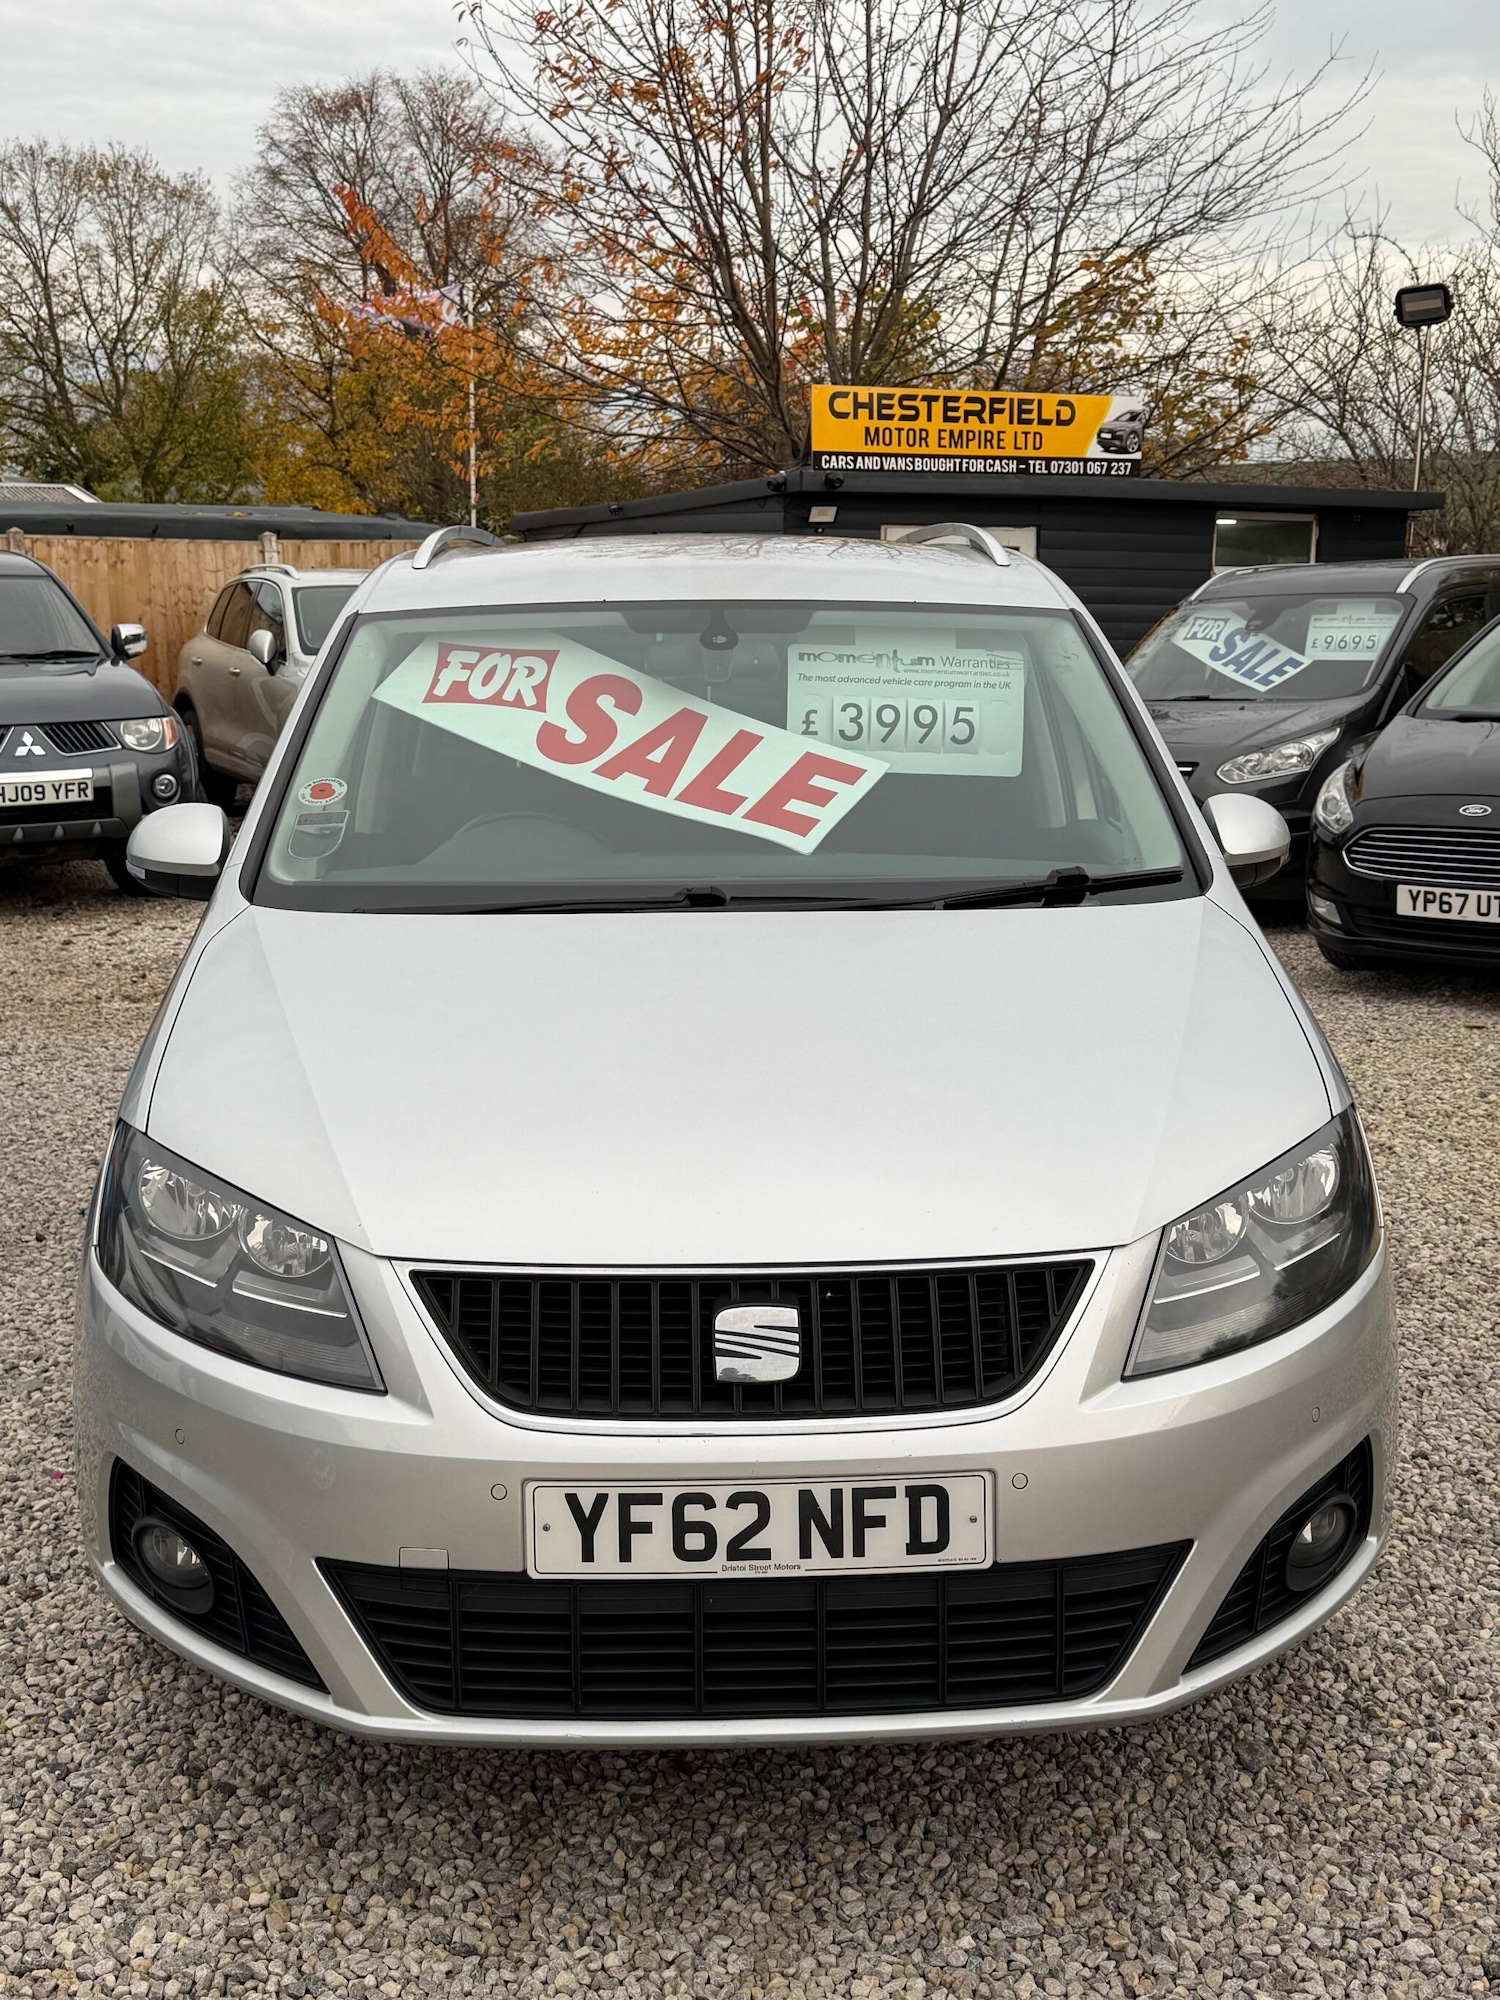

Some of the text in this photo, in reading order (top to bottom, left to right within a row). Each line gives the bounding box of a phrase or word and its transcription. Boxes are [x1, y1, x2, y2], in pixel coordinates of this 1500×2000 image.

[828, 391, 1076, 426] CHESTERFIELD
[864, 426, 1043, 451] MOTOR EMPIRE LTD
[821, 455, 854, 469] CARS
[856, 456, 881, 469] AND
[881, 457, 914, 471] VANS
[914, 458, 962, 472] BOUGHT
[963, 458, 985, 472] FOR
[986, 459, 1017, 473] CASH
[1028, 460, 1048, 474] TEL
[1050, 460, 1086, 475] 07301
[1087, 461, 1109, 475] 067
[1111, 461, 1132, 476] 237
[1186, 618, 1225, 641] FOR
[798, 649, 1011, 673] momentum Warranties
[1209, 627, 1304, 687] SALE
[432, 648, 549, 708] FOR
[798, 673, 813, 682] The
[815, 674, 836, 683] most
[837, 675, 880, 684] advanced
[882, 677, 912, 686] vehicle
[934, 680, 972, 690] program
[973, 681, 981, 689] in
[983, 681, 997, 689] the
[999, 681, 1012, 690] UK
[902, 667, 1010, 678] www.momentumwarranties.co.uk
[838, 702, 976, 745] 3995
[536, 673, 868, 838] SALE
[52, 782, 89, 800] YFR
[1408, 889, 1469, 915] YP67
[564, 1484, 951, 1562] YF62 NFD
[721, 1564, 746, 1572] Bristol
[773, 1563, 801, 1571] Motors
